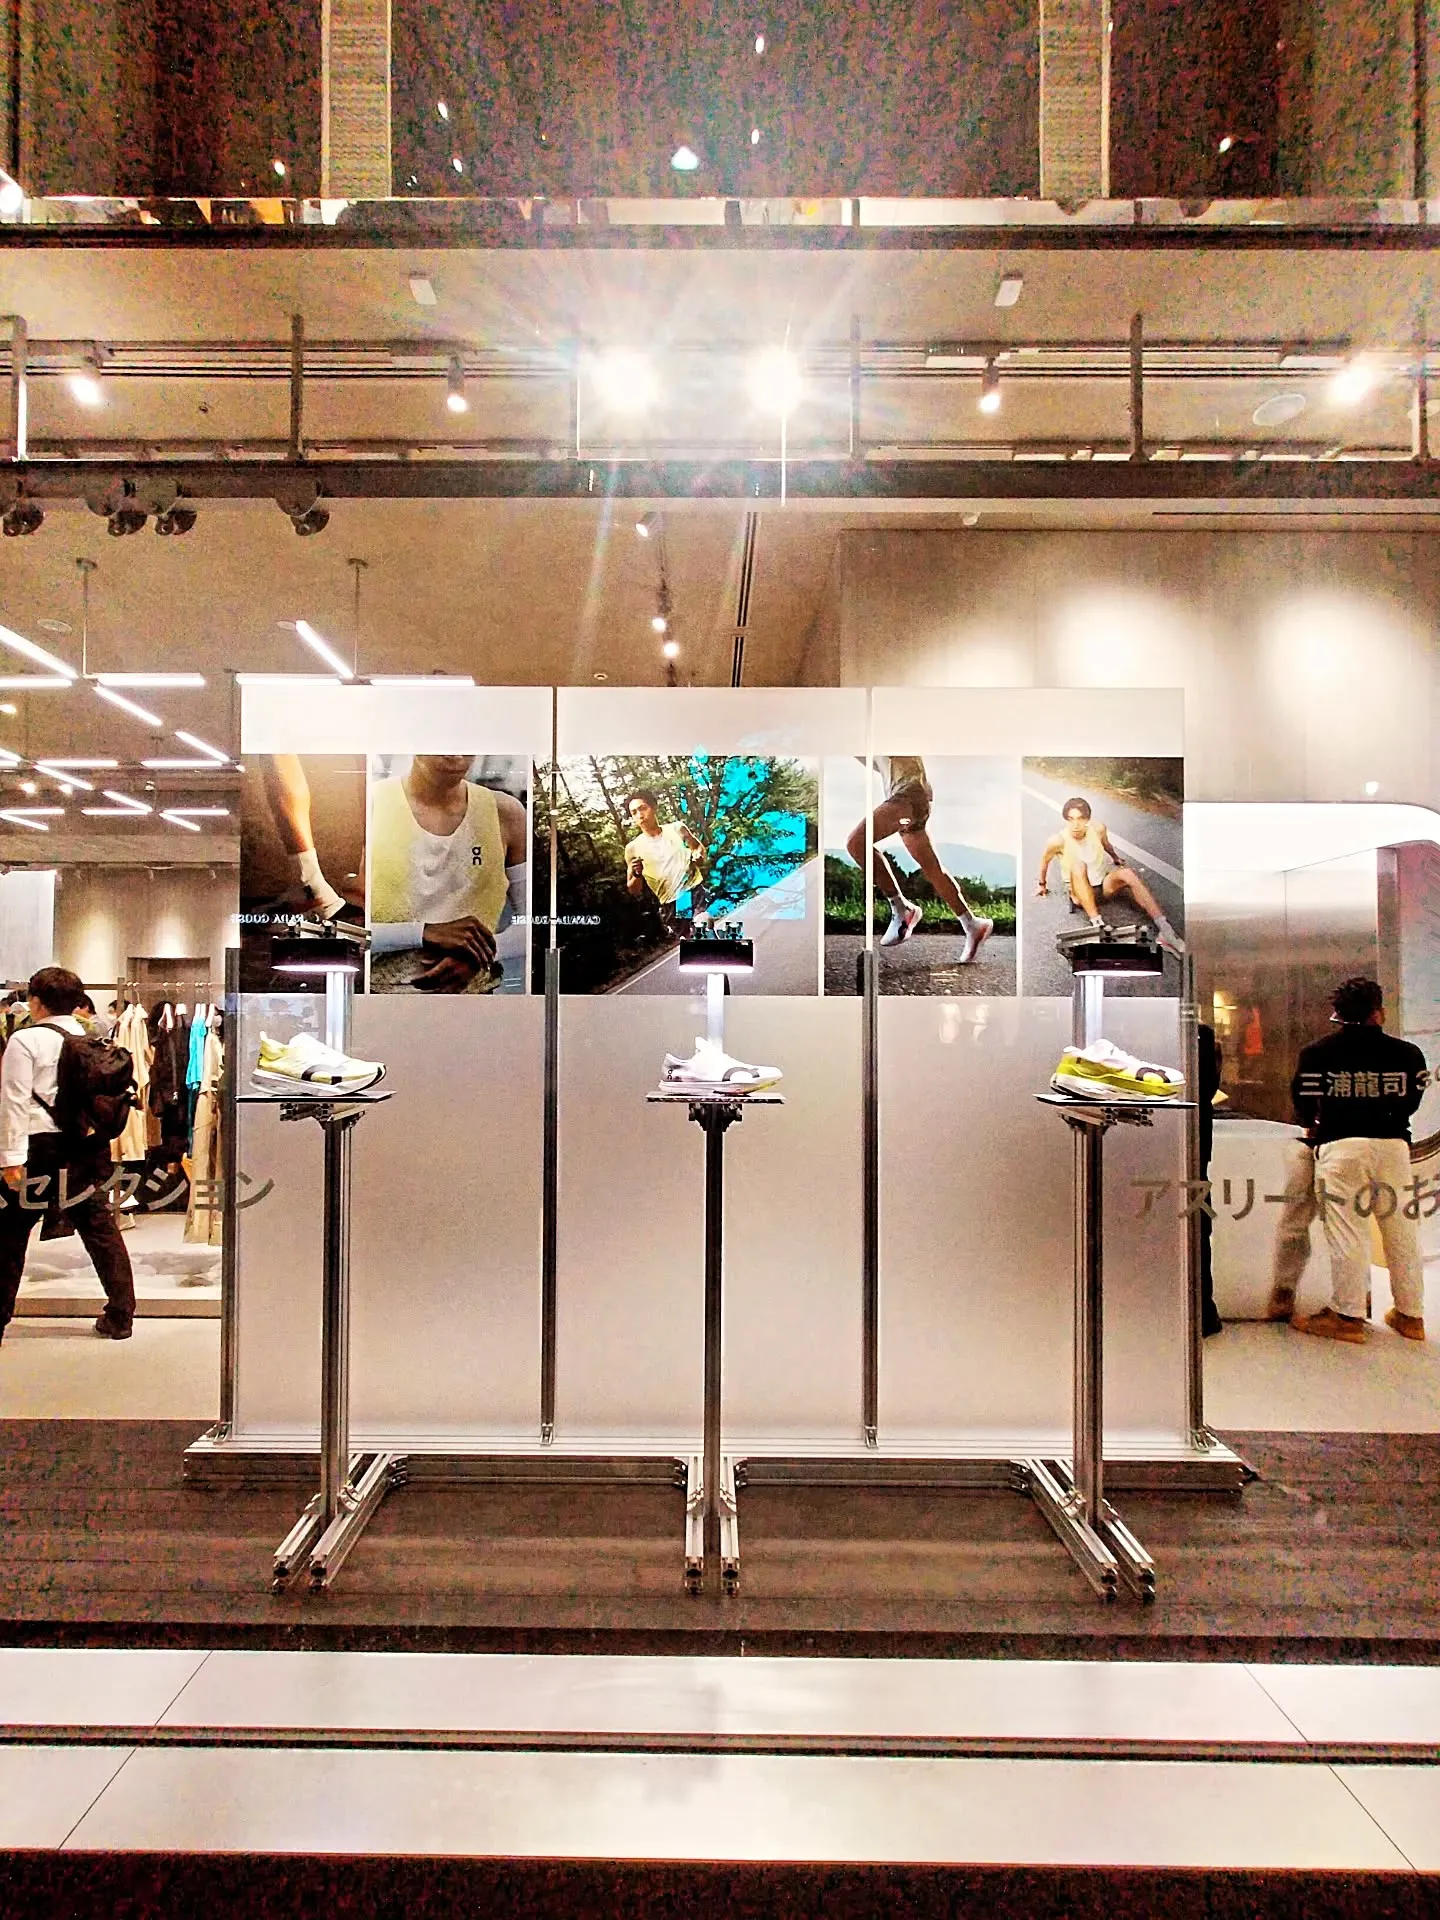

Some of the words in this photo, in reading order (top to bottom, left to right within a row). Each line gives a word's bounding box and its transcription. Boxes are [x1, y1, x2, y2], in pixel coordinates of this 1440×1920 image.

[1299, 1071, 1407, 1097] 三浦龍司
[0, 1166, 274, 1212] セレクション
[1130, 1175, 1440, 1221] アスリートのお
